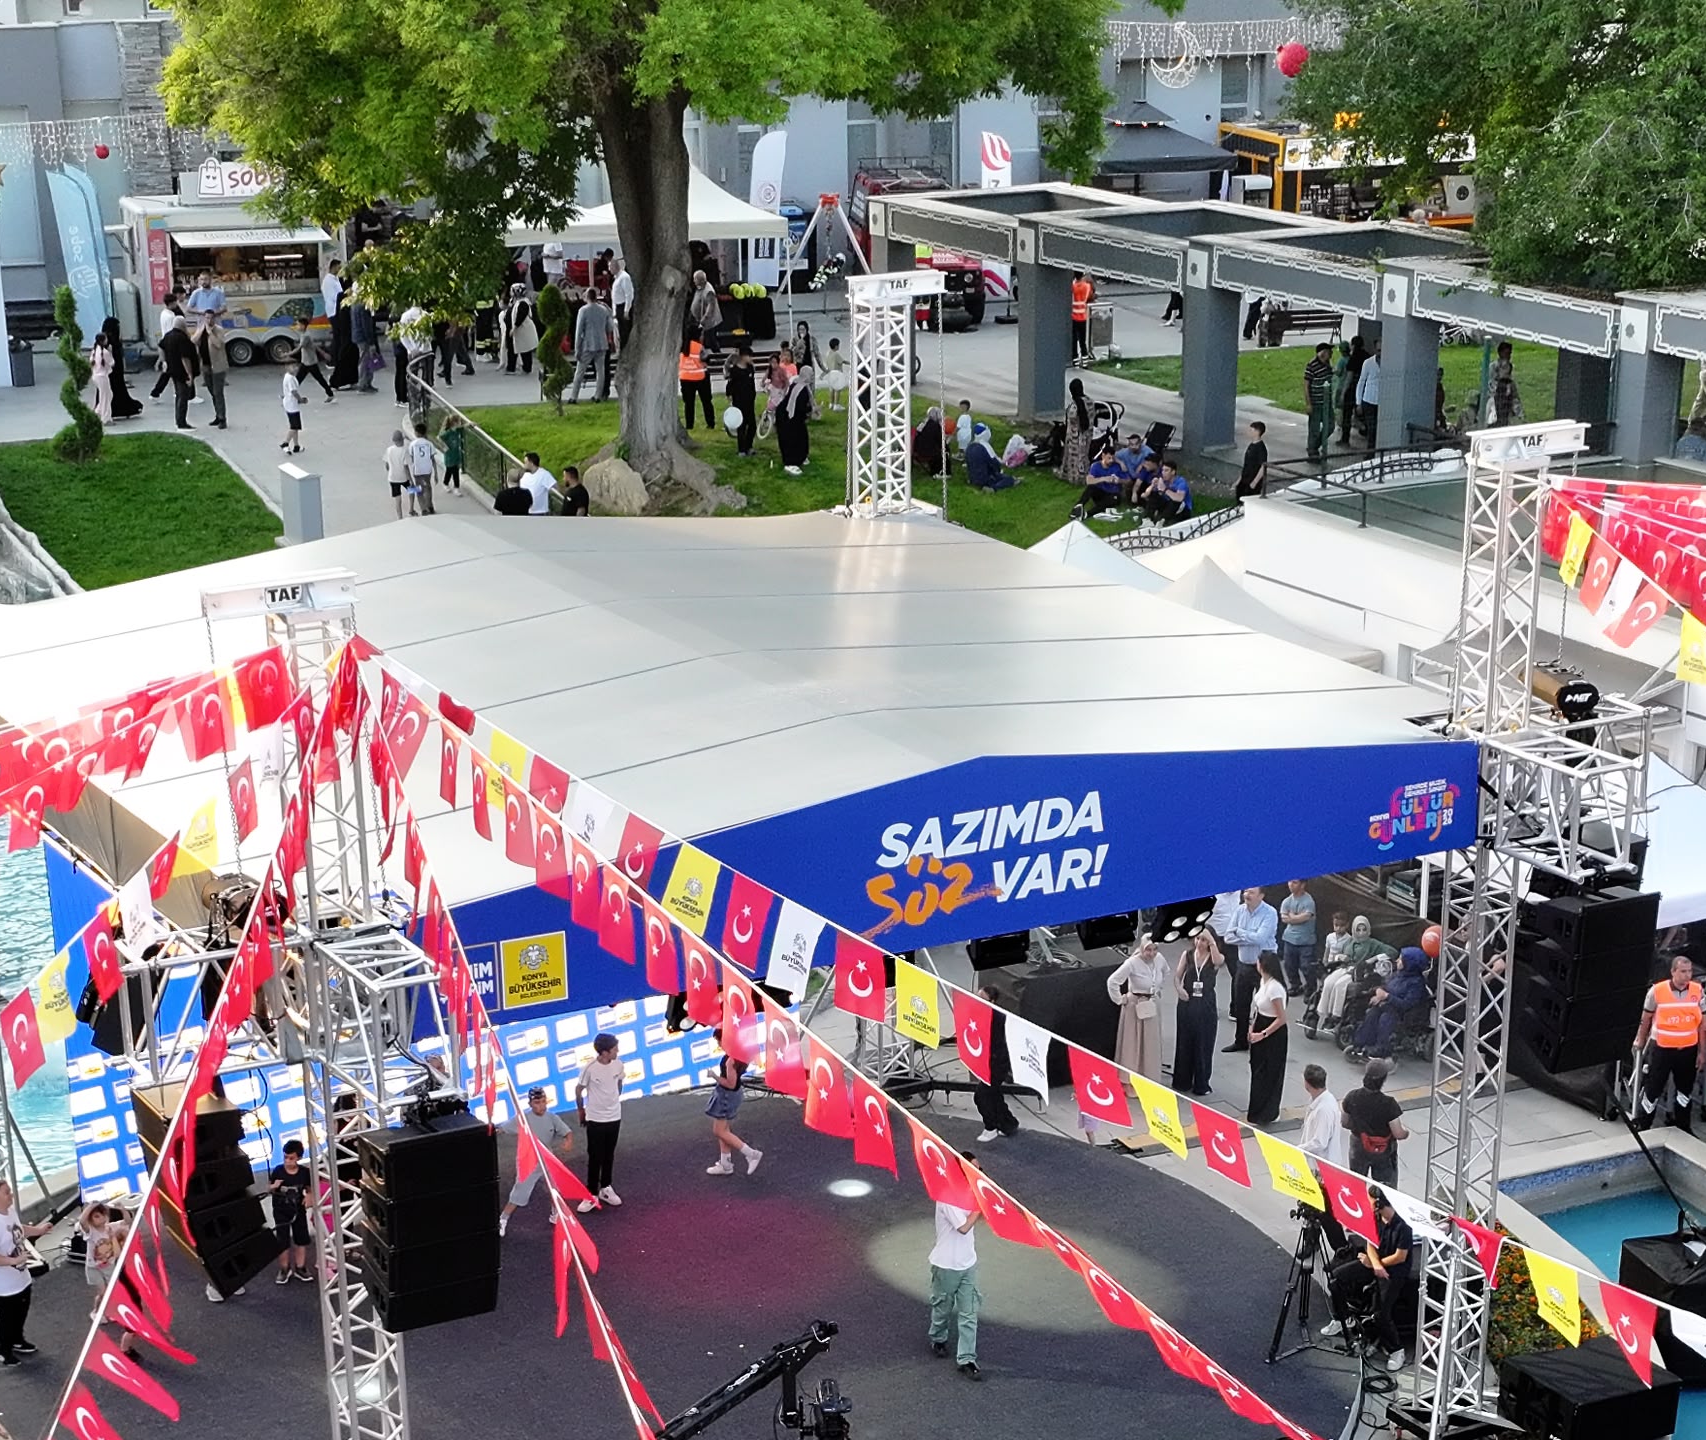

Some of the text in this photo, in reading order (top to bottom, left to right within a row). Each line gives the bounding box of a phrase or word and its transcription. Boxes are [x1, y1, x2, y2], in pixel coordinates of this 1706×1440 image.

[889, 279, 909, 290] TAF
[1522, 434, 1543, 448] TAF
[268, 586, 300, 602] TAF
[876, 790, 1104, 868] SAZIMDA
[993, 844, 1109, 903] VAR!
[522, 971, 549, 983] KONYA
